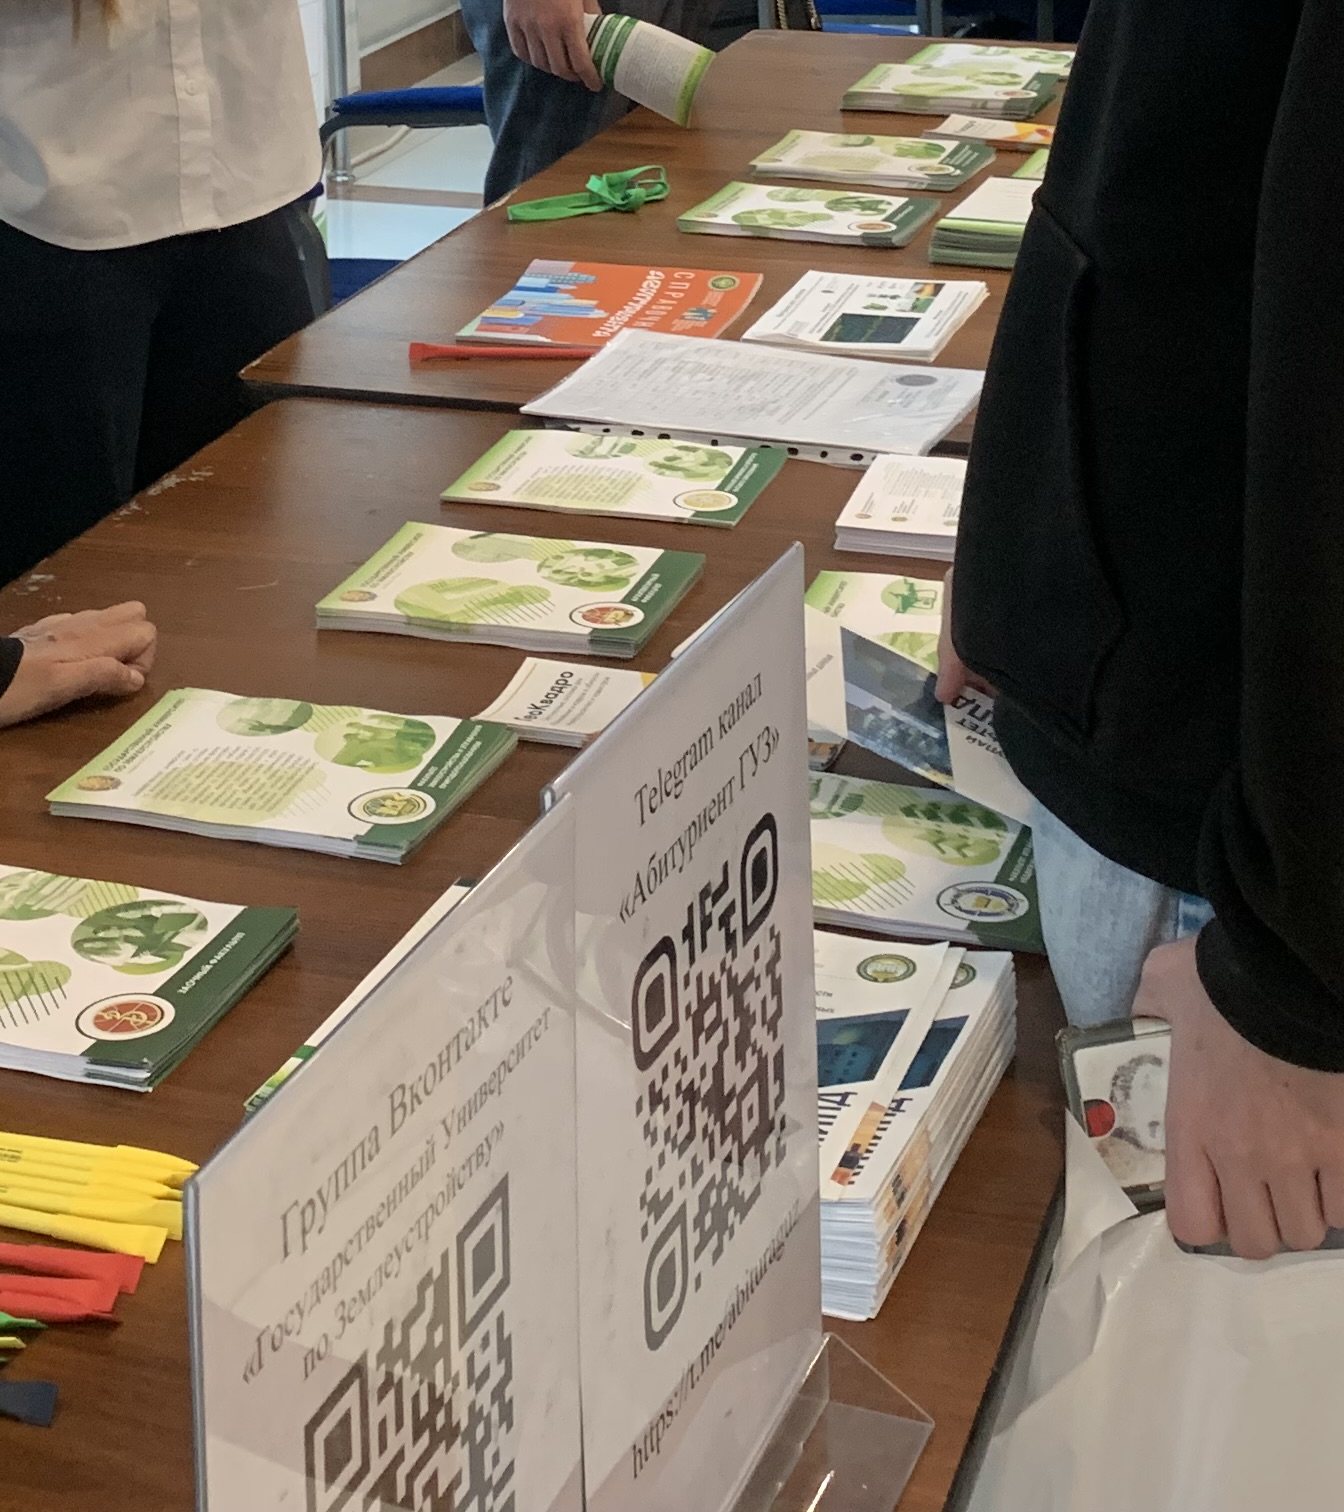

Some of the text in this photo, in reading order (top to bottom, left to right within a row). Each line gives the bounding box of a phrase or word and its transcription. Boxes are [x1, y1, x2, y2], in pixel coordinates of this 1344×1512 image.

[632, 271, 696, 328] СПРАВОЧН
[619, 774, 736, 924] «Абитуриент
[634, 672, 763, 828] Telegram канал
[242, 1007, 551, 1386] «Государственный Университет
[279, 975, 514, 1264] Группа Вконтакте
[302, 1120, 506, 1381] по Землеустройству»
